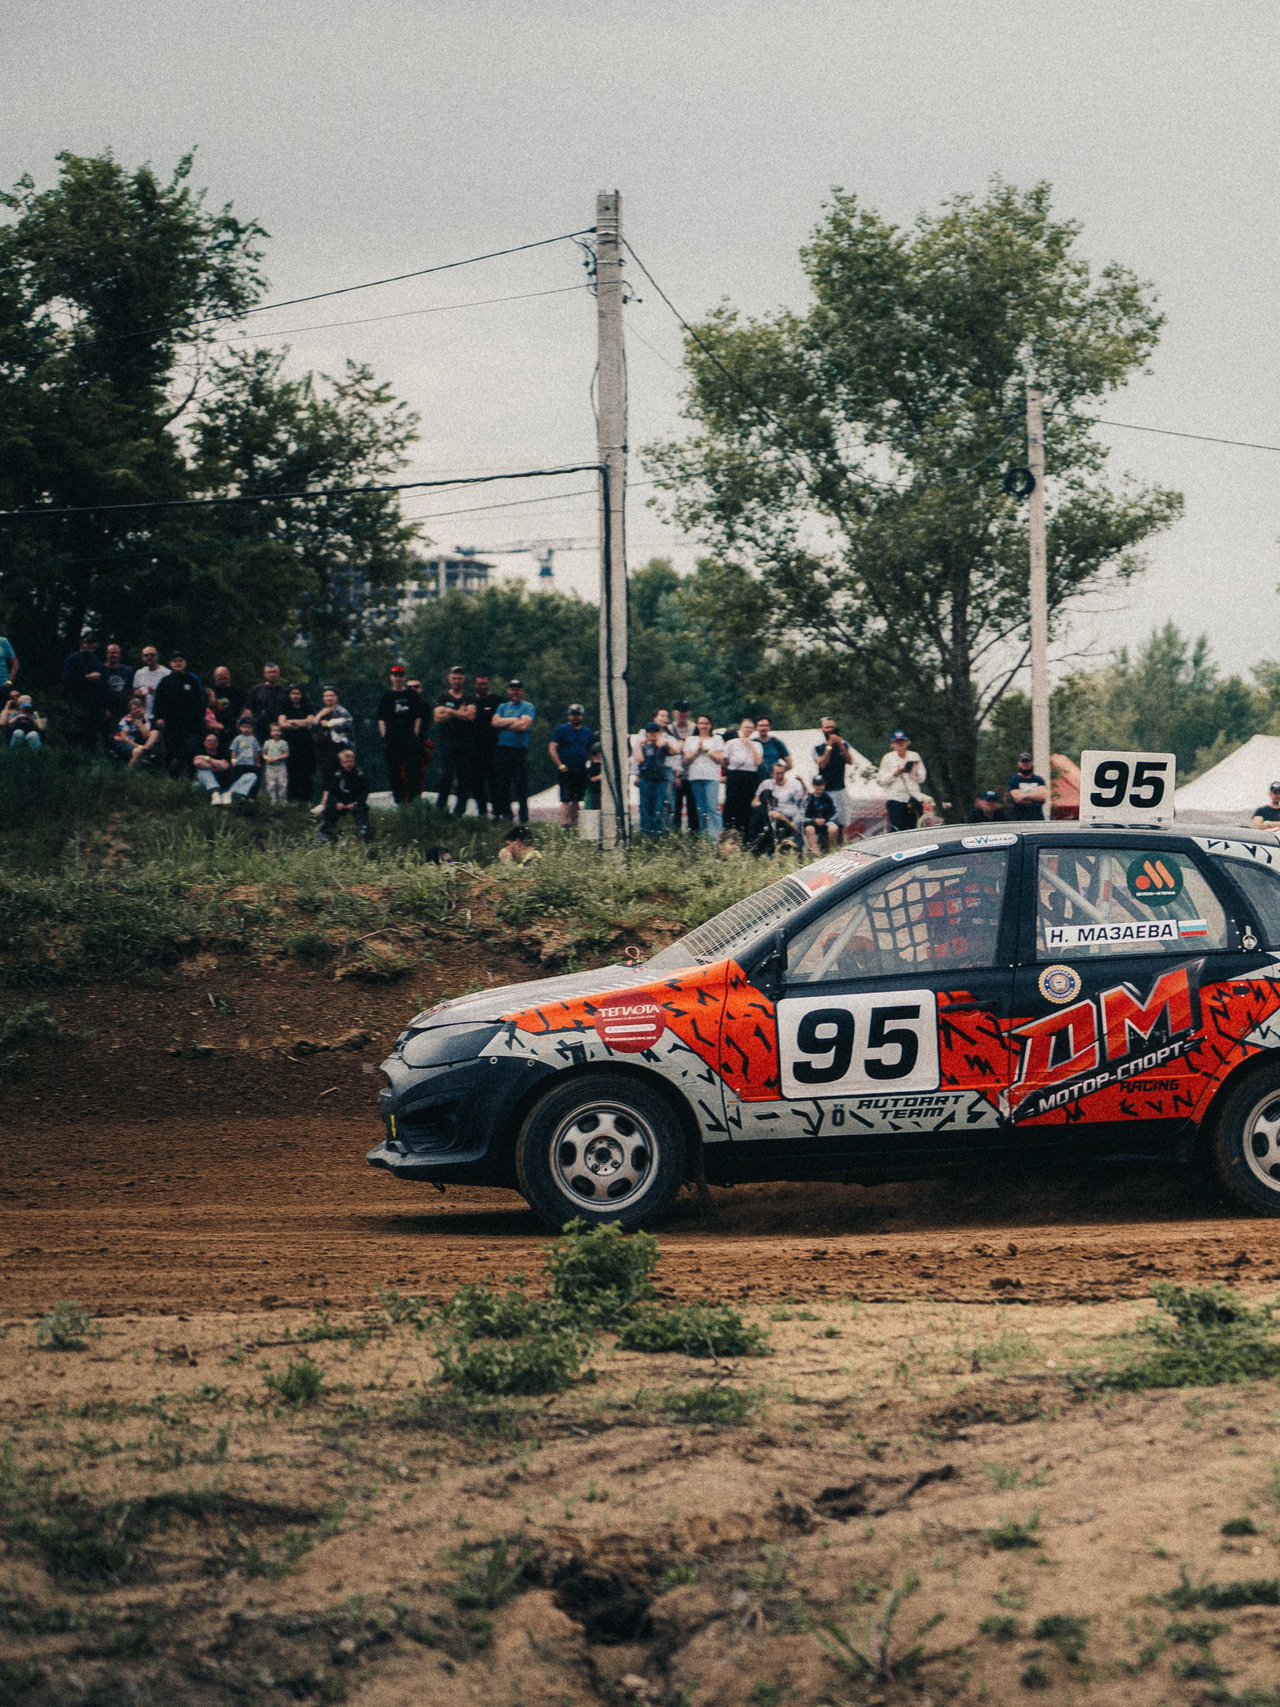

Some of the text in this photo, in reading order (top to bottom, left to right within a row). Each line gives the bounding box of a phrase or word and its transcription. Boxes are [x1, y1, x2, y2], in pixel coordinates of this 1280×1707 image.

[1090, 761, 1169, 807] 95
[1050, 924, 1173, 943] Н. МАЗАЕВА
[597, 1004, 660, 1017] ТЕПЛОТА
[792, 1005, 921, 1083] 95
[1039, 1041, 1184, 1113] МОТОР-СПОРТ
[1120, 1079, 1180, 1093] RACING
[857, 1095, 965, 1109] AUTOART
[879, 1107, 944, 1120] TEAM
